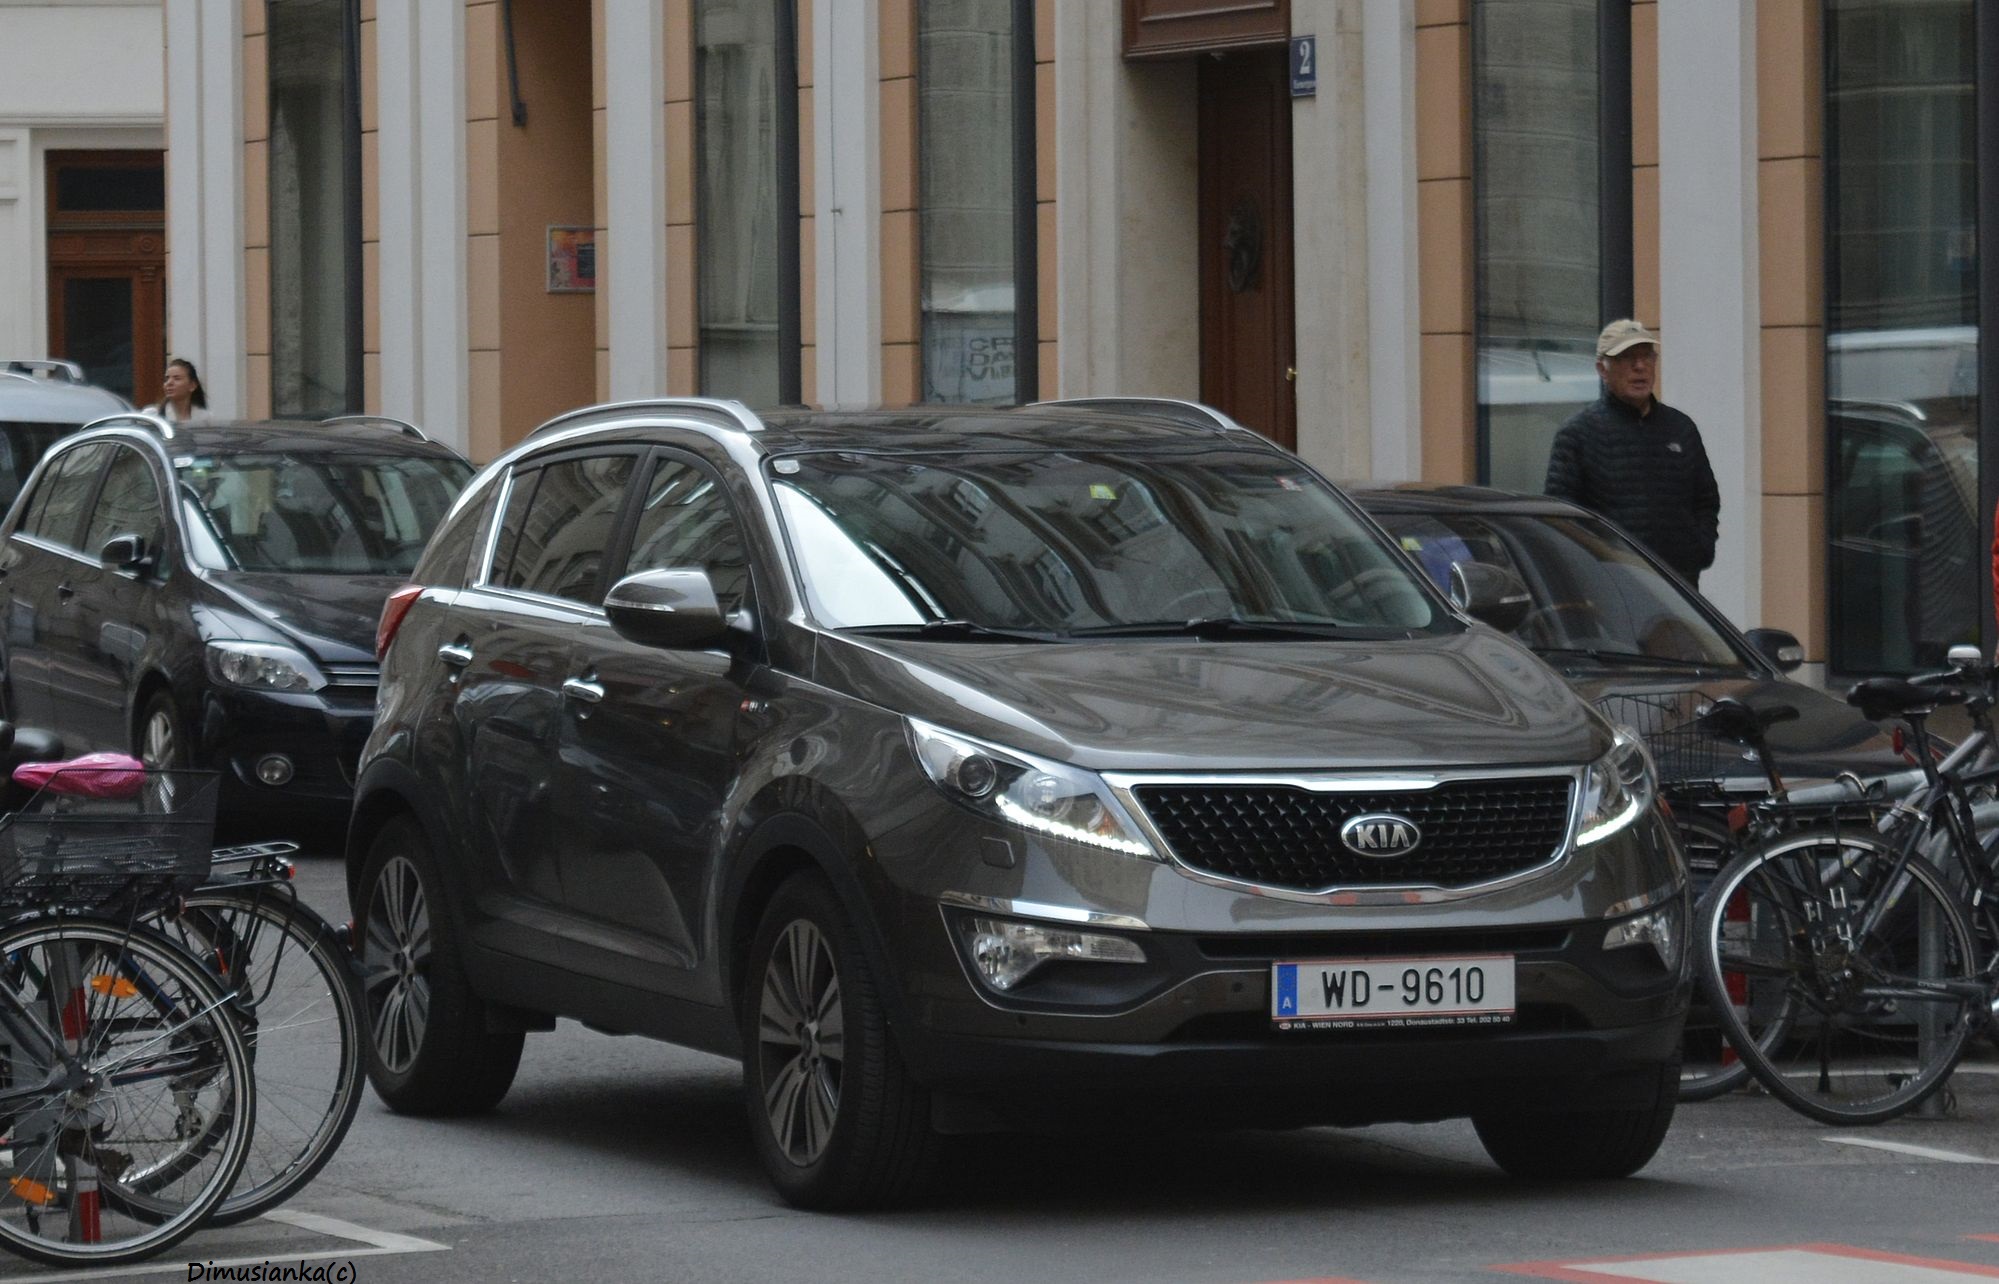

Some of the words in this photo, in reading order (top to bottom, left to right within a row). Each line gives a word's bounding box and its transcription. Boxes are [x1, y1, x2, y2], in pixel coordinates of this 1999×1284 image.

[1299, 40, 1310, 74] 2
[1356, 824, 1410, 848] KIA
[1321, 966, 1484, 1009] WD-9610
[1282, 997, 1292, 1009] A
[1293, 1022, 1306, 1030] KIA
[1312, 1021, 1332, 1029] WIEN
[1332, 1020, 1354, 1029] NORD
